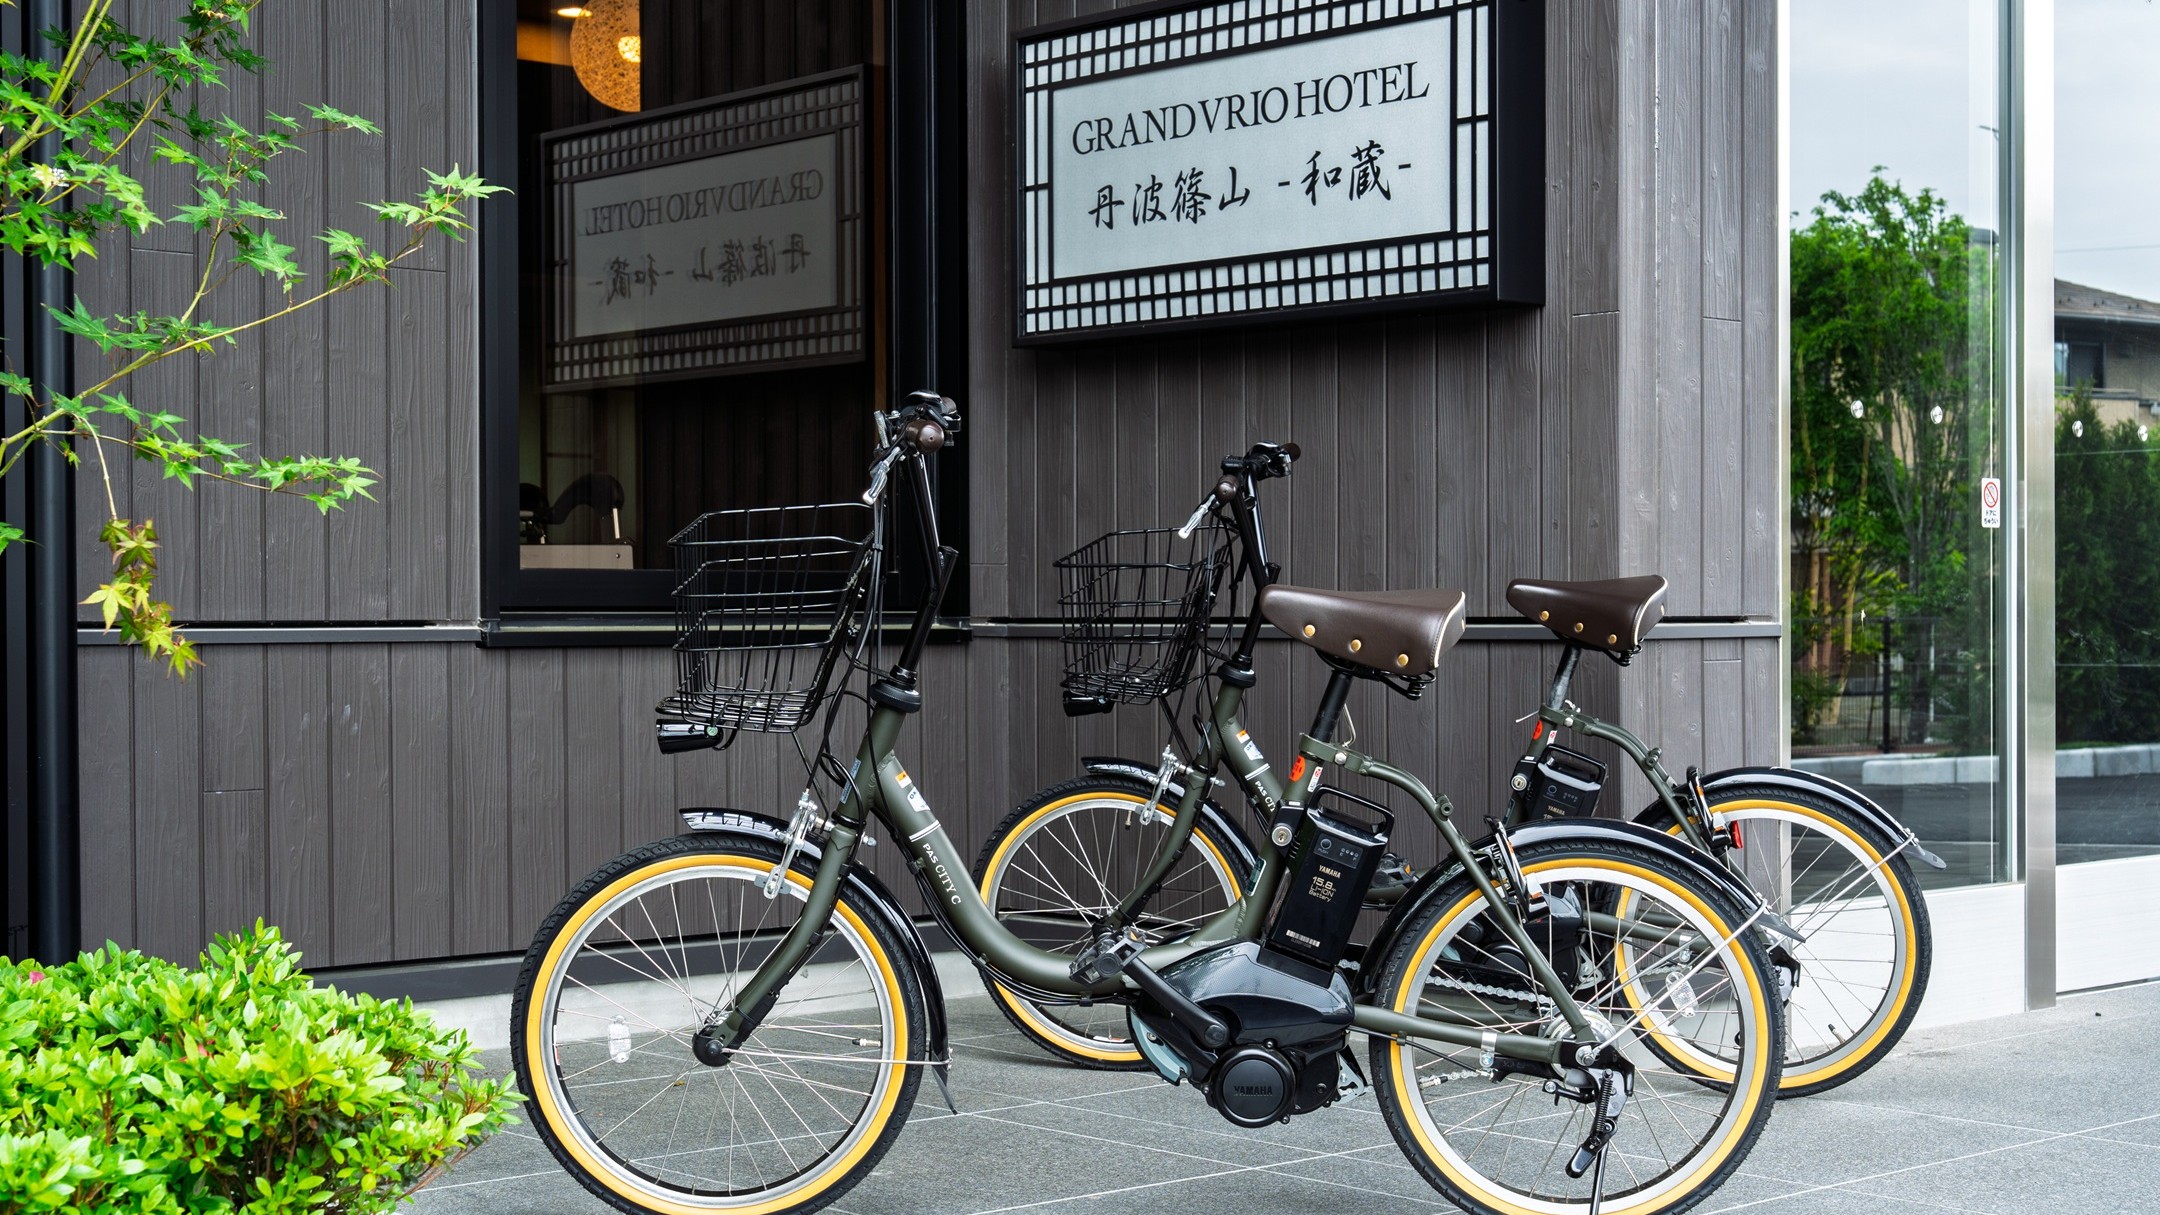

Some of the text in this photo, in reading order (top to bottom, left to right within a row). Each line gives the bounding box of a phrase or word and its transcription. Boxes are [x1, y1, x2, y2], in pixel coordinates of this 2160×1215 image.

[1293, 61, 1430, 119] HOTEL
[1088, 167, 1251, 230] 丹波篠山
[1255, 781, 1276, 812] PAS CIT
[922, 843, 962, 905] PAS CITY C
[1319, 865, 1341, 879] YAMAHA
[1308, 890, 1331, 902] Battery
[1233, 1085, 1273, 1096] YAMAHA
